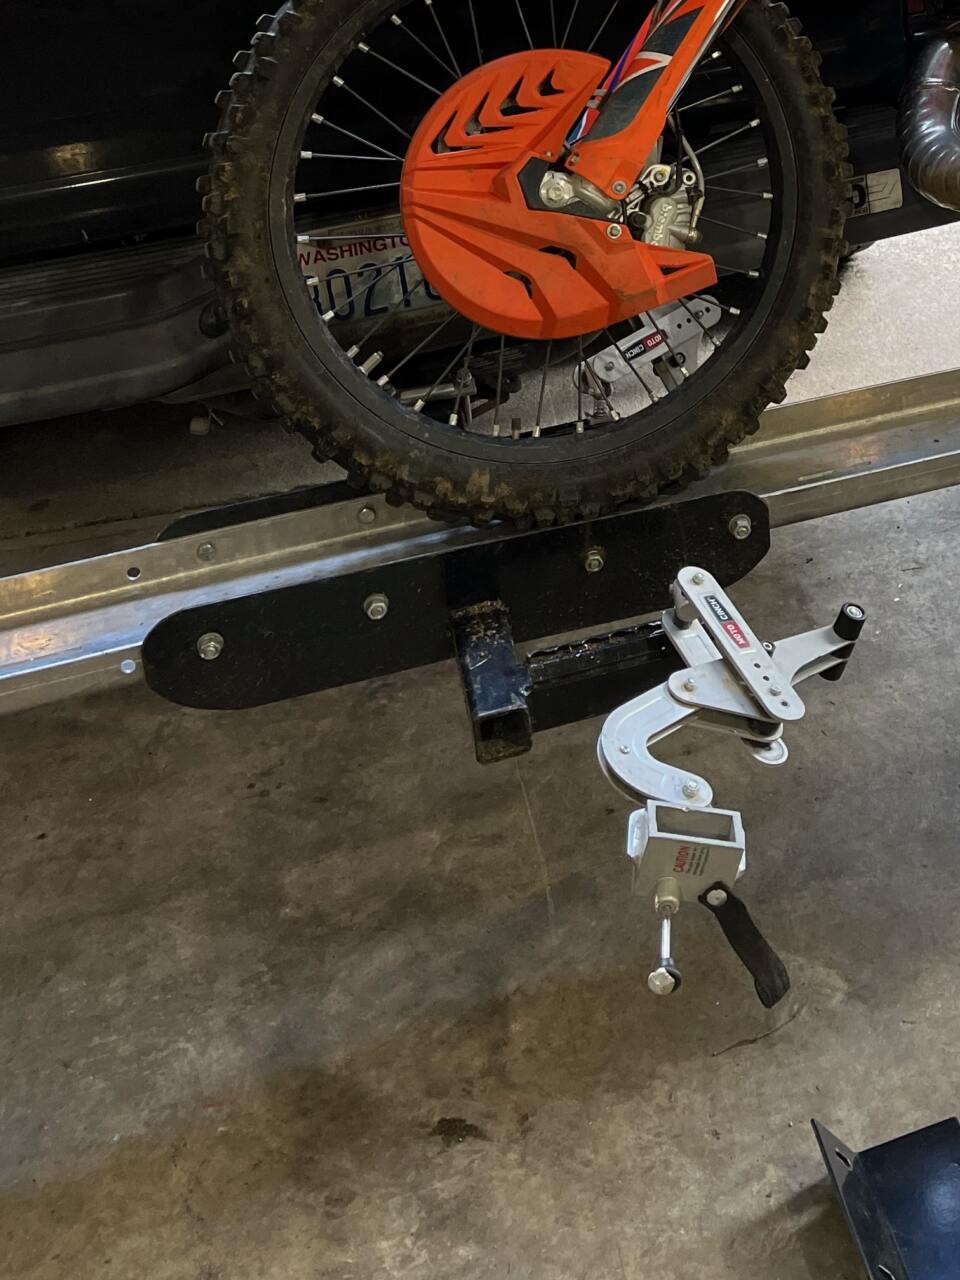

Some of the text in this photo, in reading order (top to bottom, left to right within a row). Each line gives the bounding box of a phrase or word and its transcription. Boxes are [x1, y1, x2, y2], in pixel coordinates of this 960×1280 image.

[707, 597, 747, 645] MOTO CINCH
[673, 845, 690, 873] CAUTION
